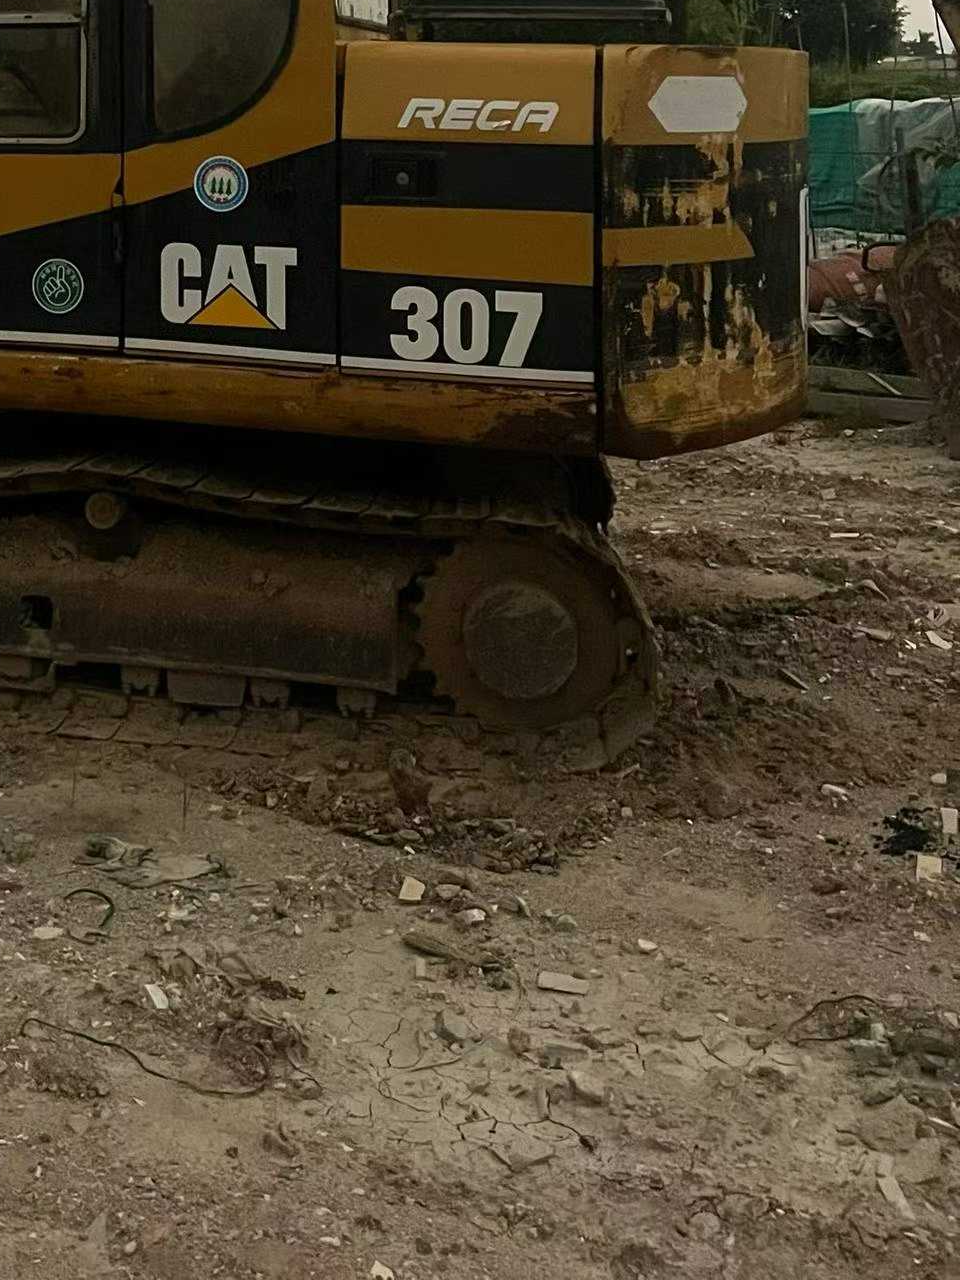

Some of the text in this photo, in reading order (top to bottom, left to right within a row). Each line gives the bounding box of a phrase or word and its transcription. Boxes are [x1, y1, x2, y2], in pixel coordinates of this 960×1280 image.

[397, 98, 559, 132] RECA
[161, 242, 297, 330] CAT
[390, 286, 543, 367] 307
